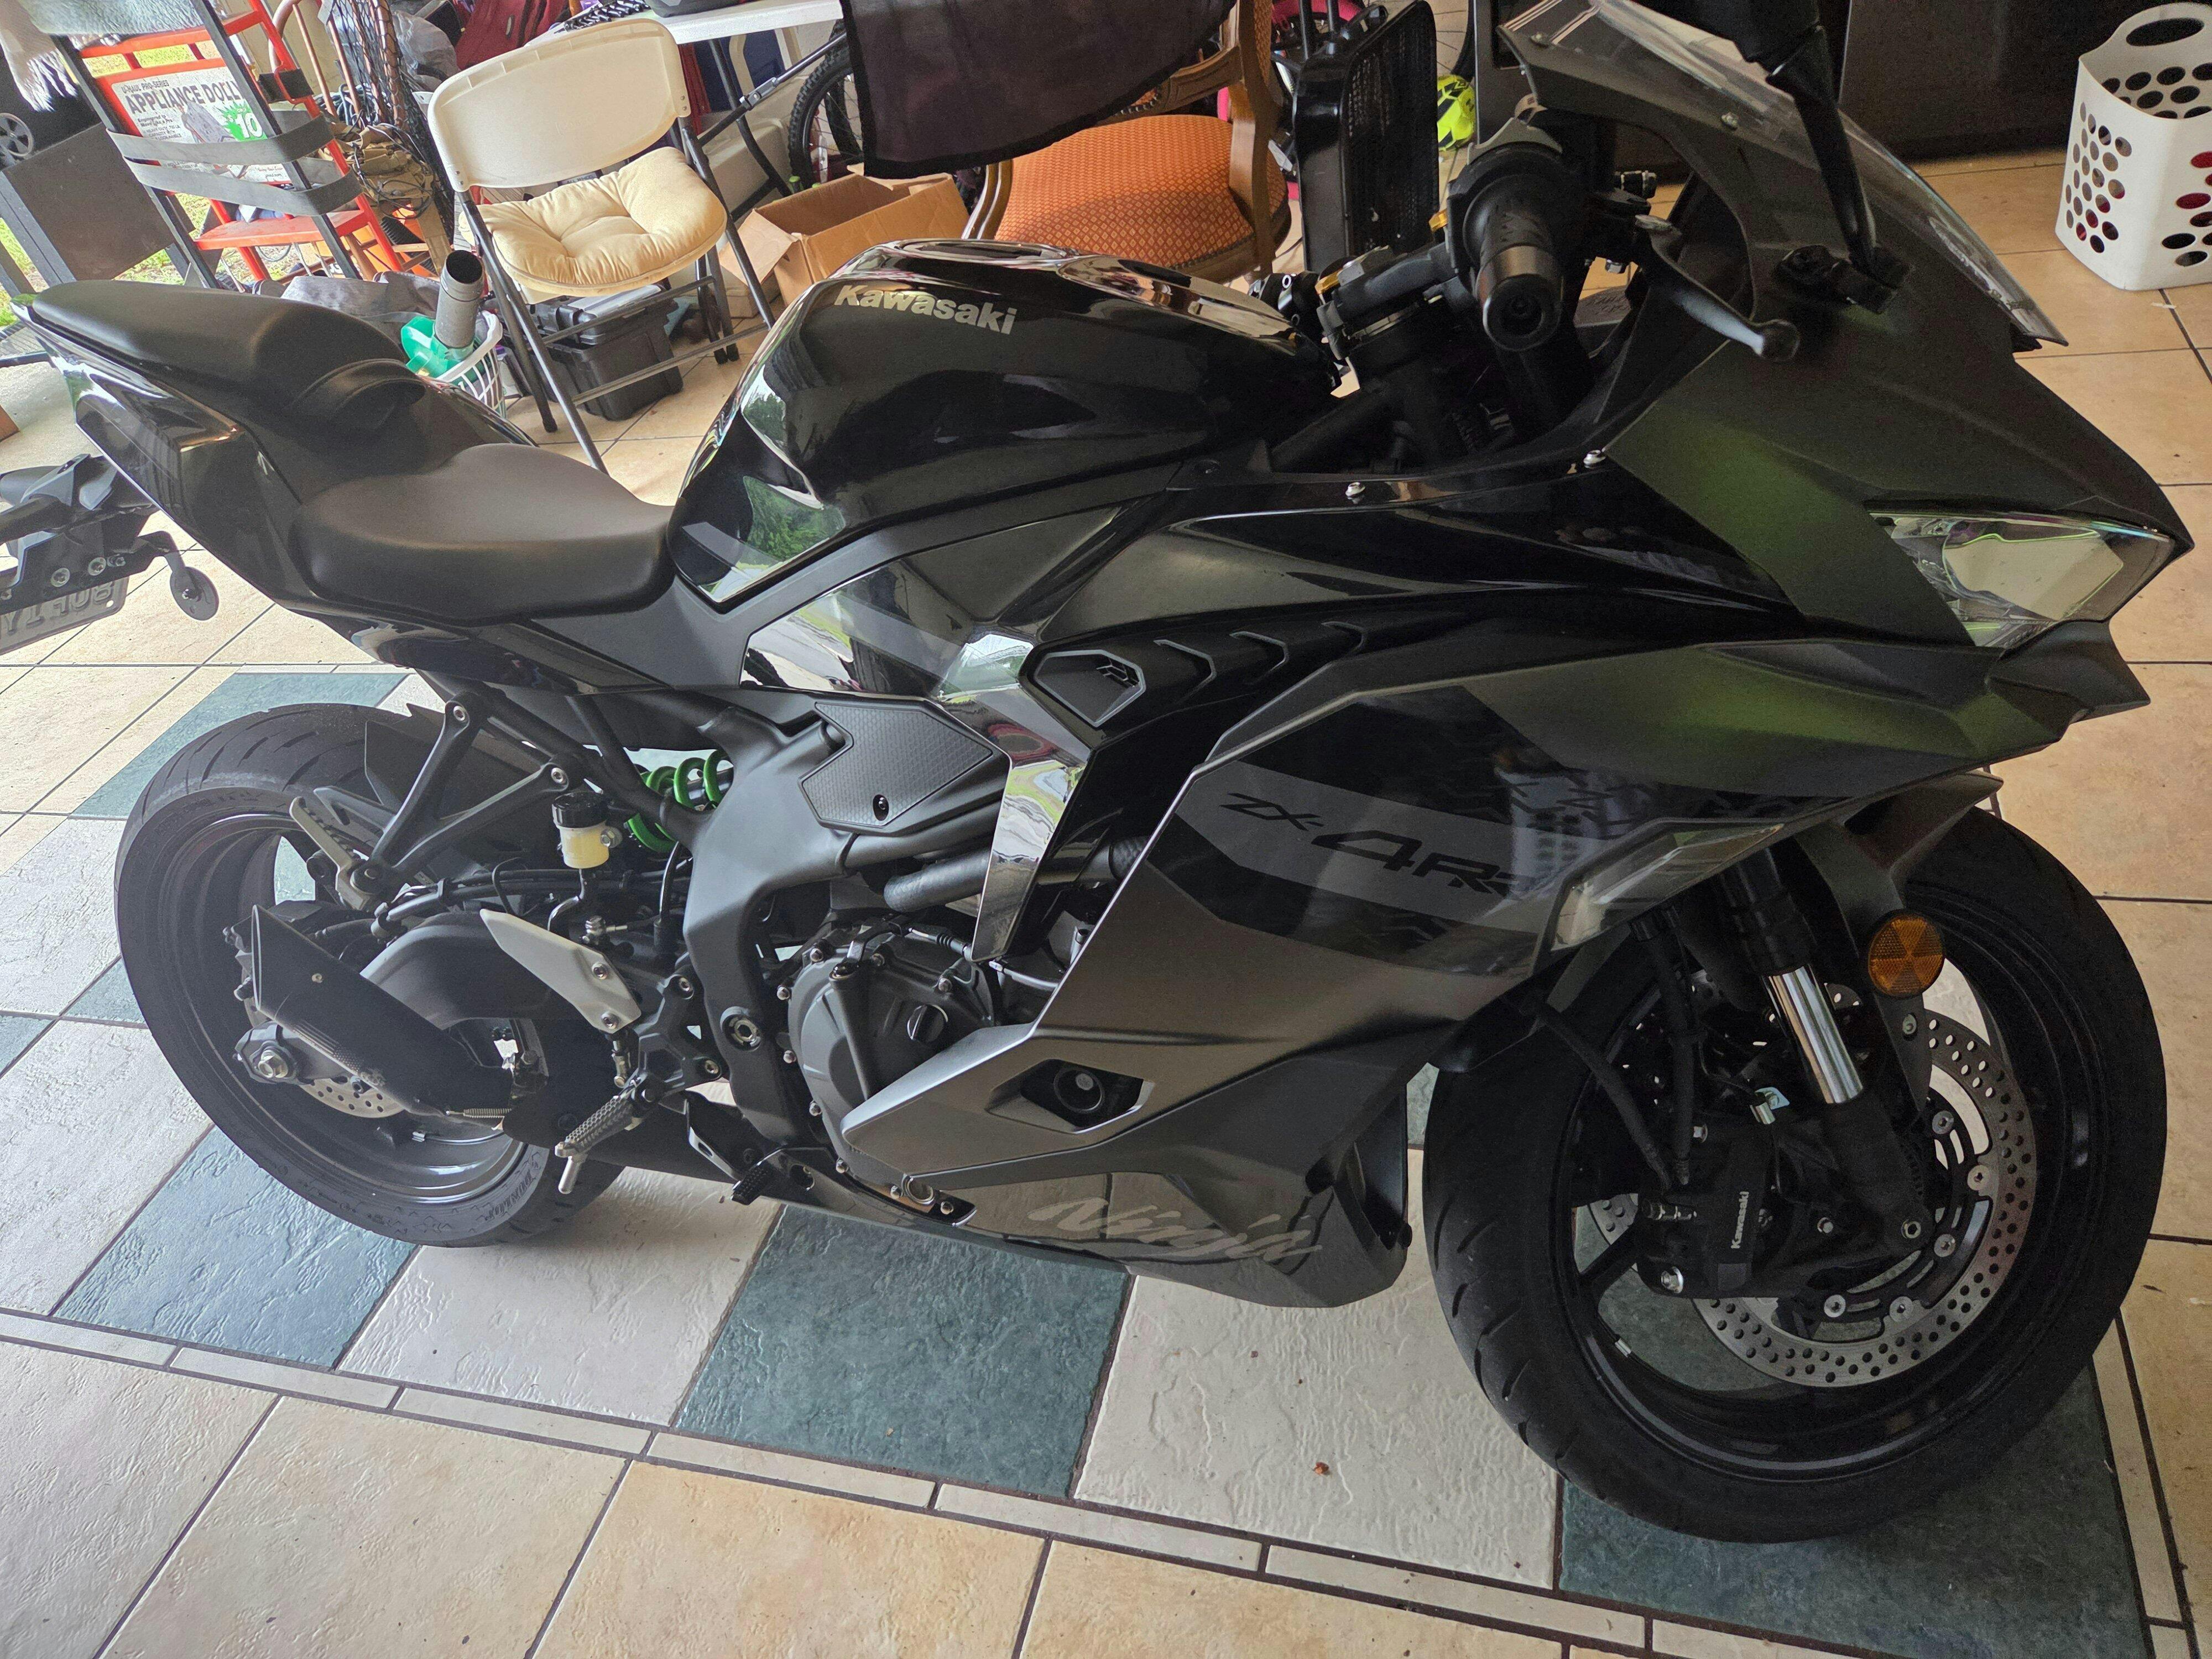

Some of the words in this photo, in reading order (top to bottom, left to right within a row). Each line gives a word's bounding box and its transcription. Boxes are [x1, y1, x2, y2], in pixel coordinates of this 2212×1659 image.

[121, 85, 142, 93] U-HAUL
[141, 80, 169, 90] PRO-SERIES
[125, 85, 206, 114] APPLIANCE
[834, 284, 1018, 335] Kawasaki
[1730, 1191, 1749, 1248] Kawasaki
